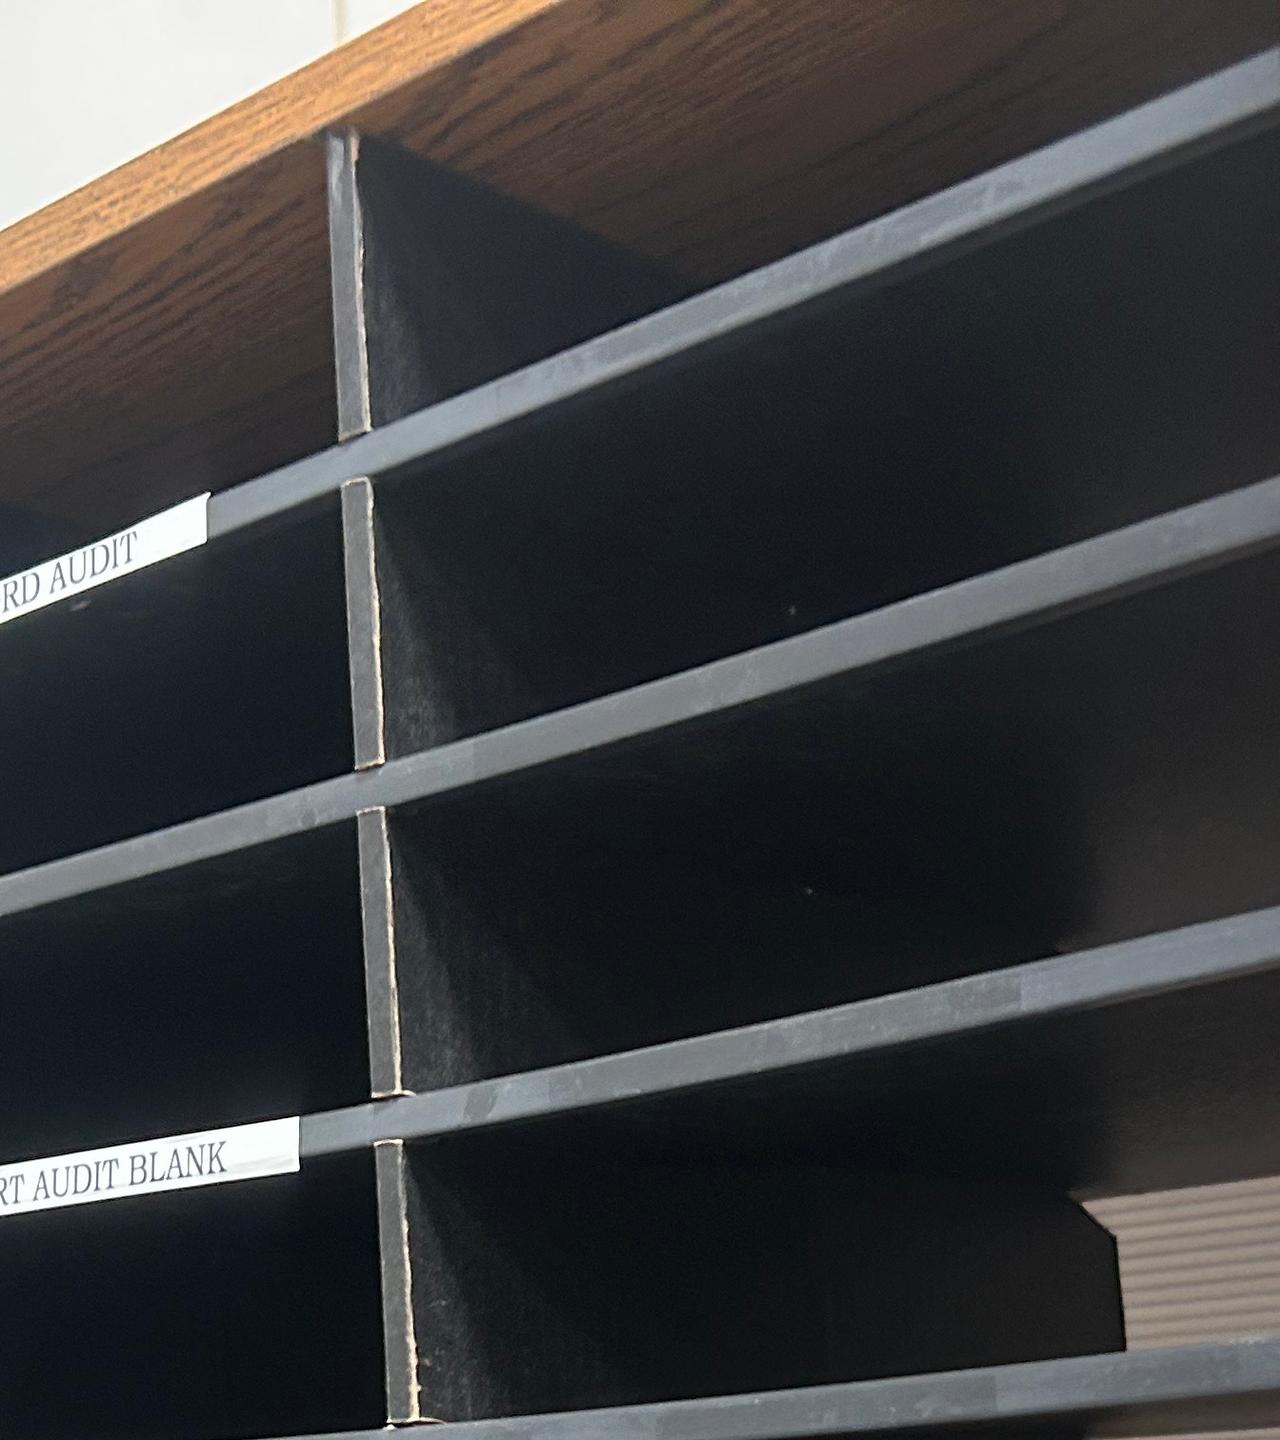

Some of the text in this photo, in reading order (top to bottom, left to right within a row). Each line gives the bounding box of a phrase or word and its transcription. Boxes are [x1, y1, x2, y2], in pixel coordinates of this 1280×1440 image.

[49, 531, 138, 594] AUDIT
[33, 1158, 120, 1202] AUDIT
[128, 1141, 228, 1187] BLANK
